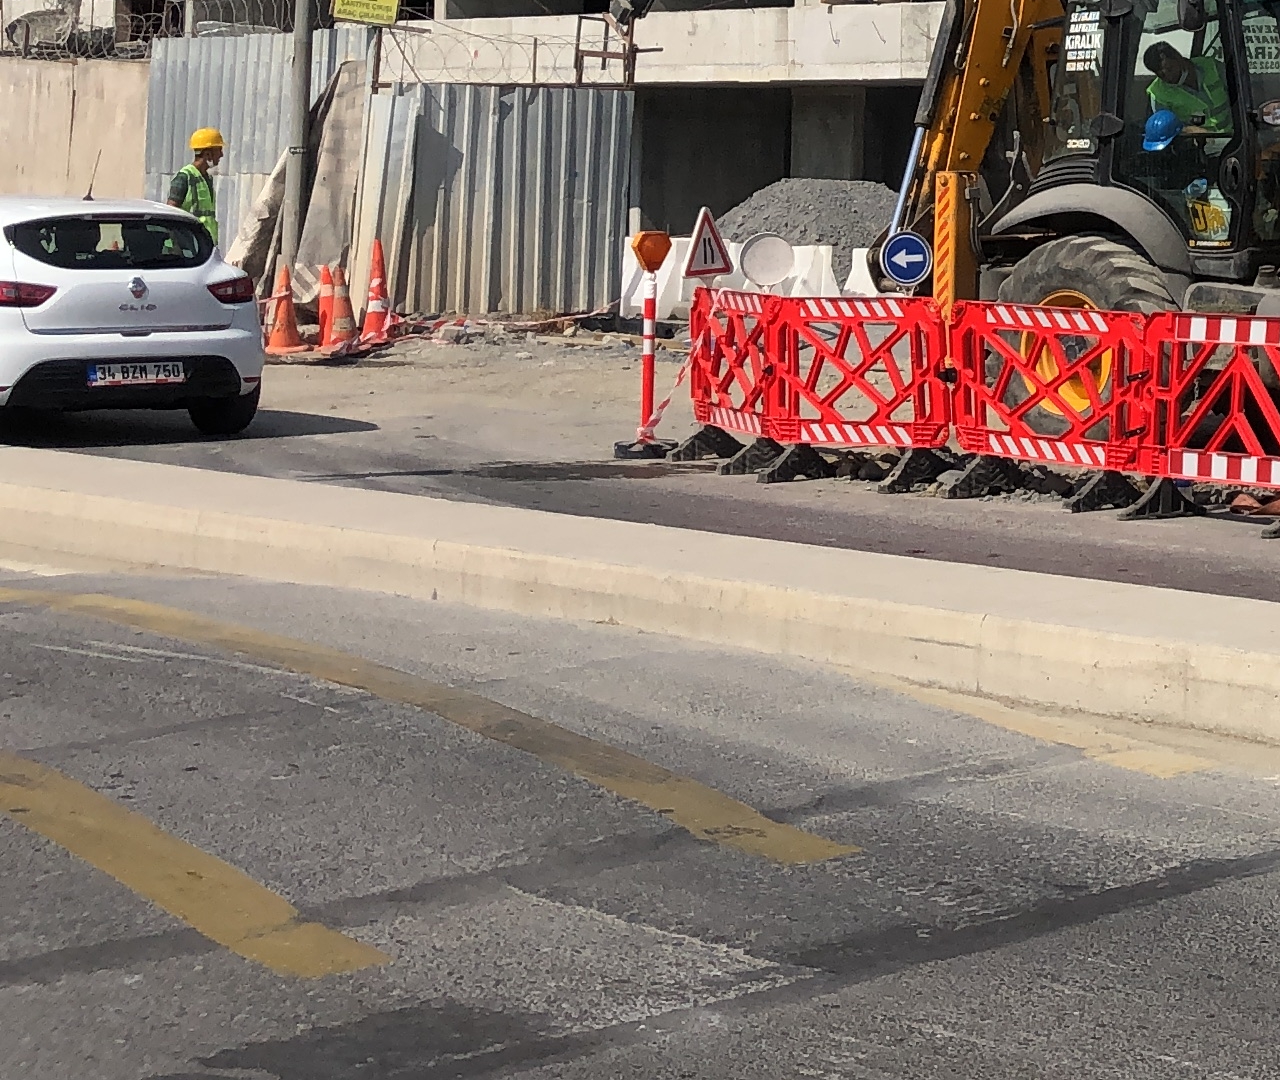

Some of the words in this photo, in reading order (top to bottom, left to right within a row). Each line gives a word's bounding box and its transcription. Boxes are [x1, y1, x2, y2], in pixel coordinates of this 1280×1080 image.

[118, 303, 157, 311] CLIO
[98, 365, 116, 380] 34
[120, 364, 148, 380] BZM
[153, 363, 180, 379] 750
